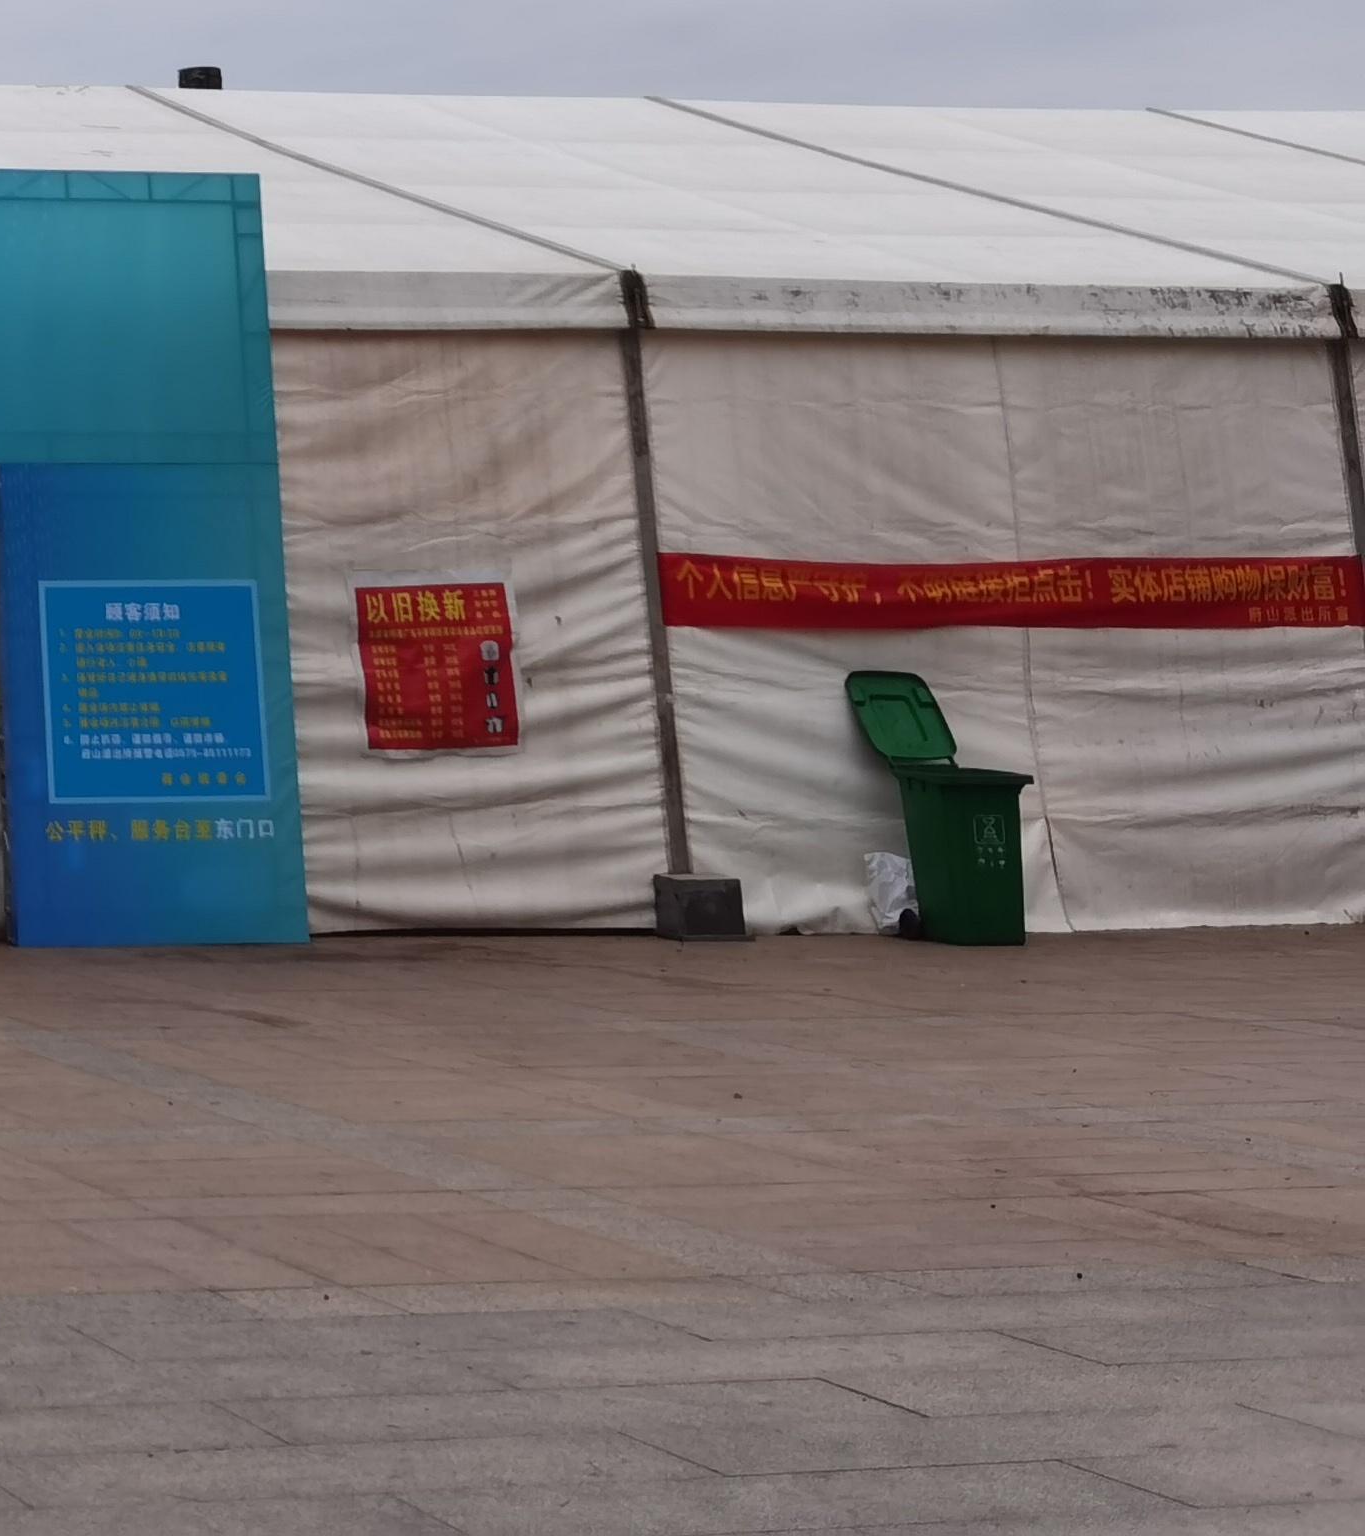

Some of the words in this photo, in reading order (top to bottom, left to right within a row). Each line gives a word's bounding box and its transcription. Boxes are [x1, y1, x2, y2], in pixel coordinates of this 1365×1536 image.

[105, 602, 181, 622] 顾客须知
[365, 589, 467, 624] 以旧换新
